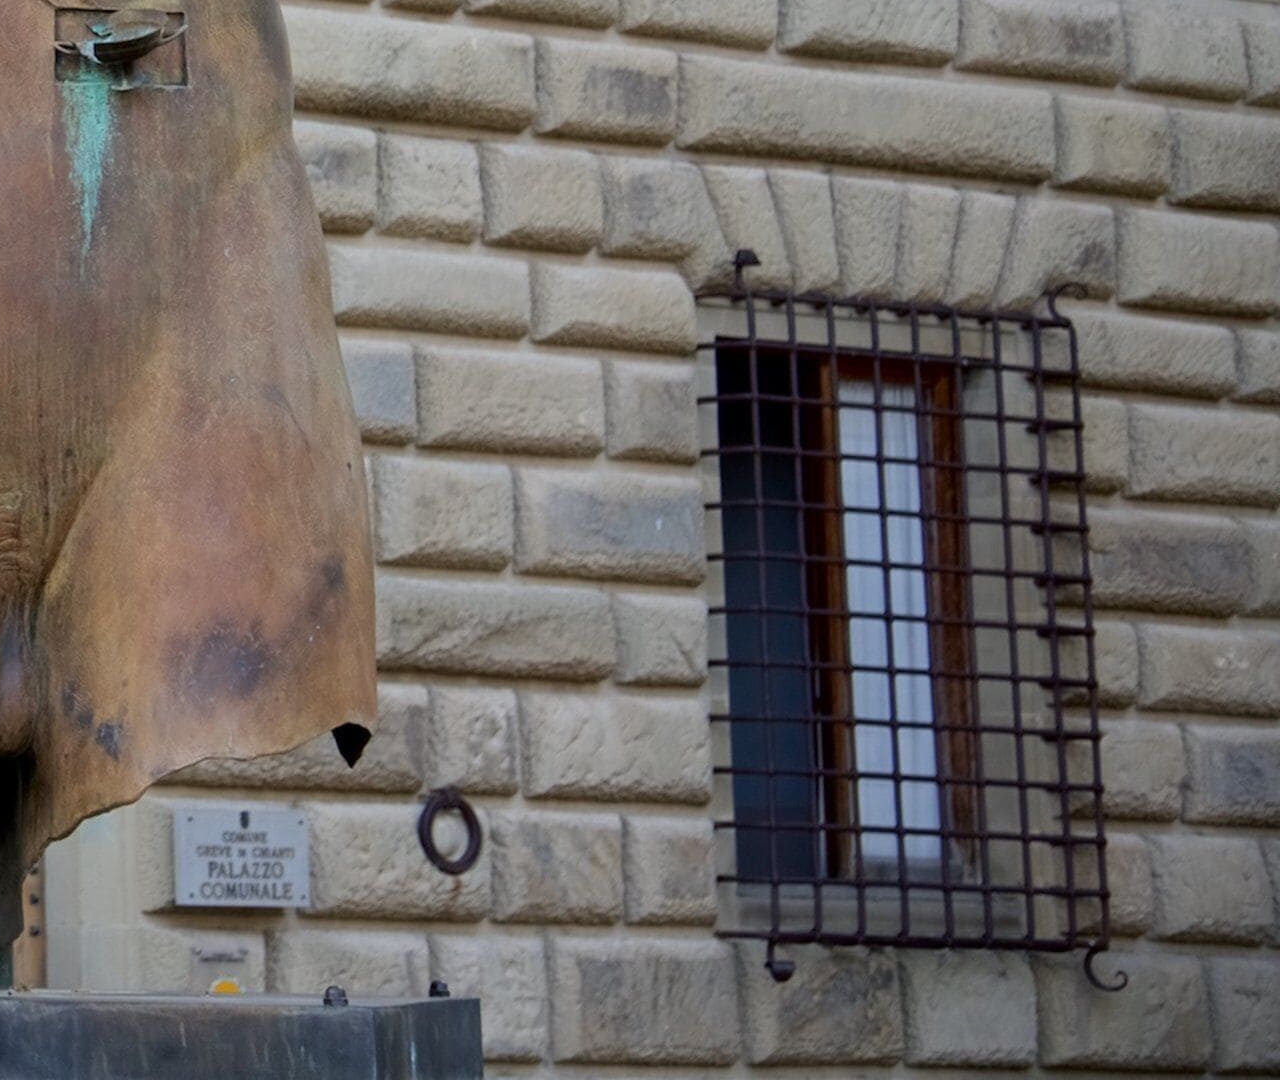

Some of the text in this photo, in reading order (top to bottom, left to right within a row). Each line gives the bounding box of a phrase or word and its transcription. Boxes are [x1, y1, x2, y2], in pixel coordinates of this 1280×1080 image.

[222, 831, 268, 843] COMUNE
[208, 861, 284, 879] PALAZZO
[200, 882, 294, 900] COMUNALE
